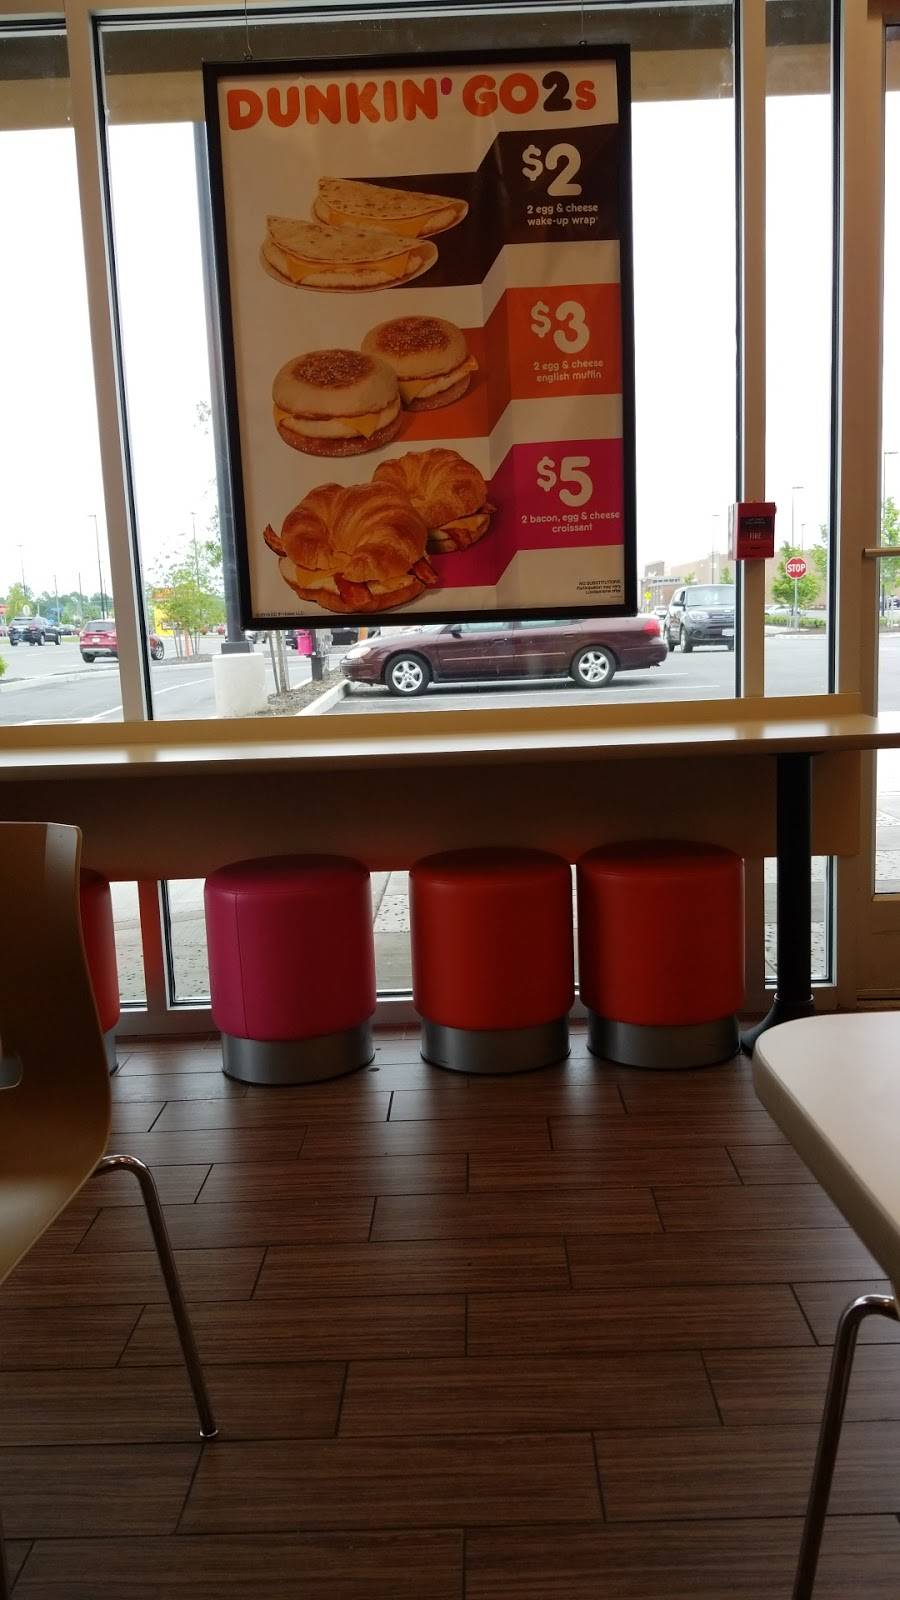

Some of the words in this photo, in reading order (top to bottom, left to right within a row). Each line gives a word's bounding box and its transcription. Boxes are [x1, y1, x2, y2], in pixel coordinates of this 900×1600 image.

[226, 76, 453, 131] DUNKIN'
[521, 142, 583, 197] $2
[526, 205, 534, 214] 2
[535, 205, 554, 215] egg
[556, 203, 564, 213] &
[565, 203, 599, 212] cheese
[527, 216, 569, 227] wake-up
[530, 300, 590, 355] $3
[534, 362, 541, 370] 2
[542, 362, 560, 372] egg
[562, 360, 569, 369] &
[570, 359, 604, 368] cheese
[536, 372, 570, 384] english
[571, 370, 602, 380] muffin
[536, 455, 594, 508] $5
[521, 516, 528, 524] 2
[530, 514, 561, 524] bacon,
[562, 514, 579, 524] egg
[580, 512, 588, 520] &
[589, 511, 621, 520] cheese
[551, 523, 593, 533] croissant
[786, 563, 806, 573] STOP
